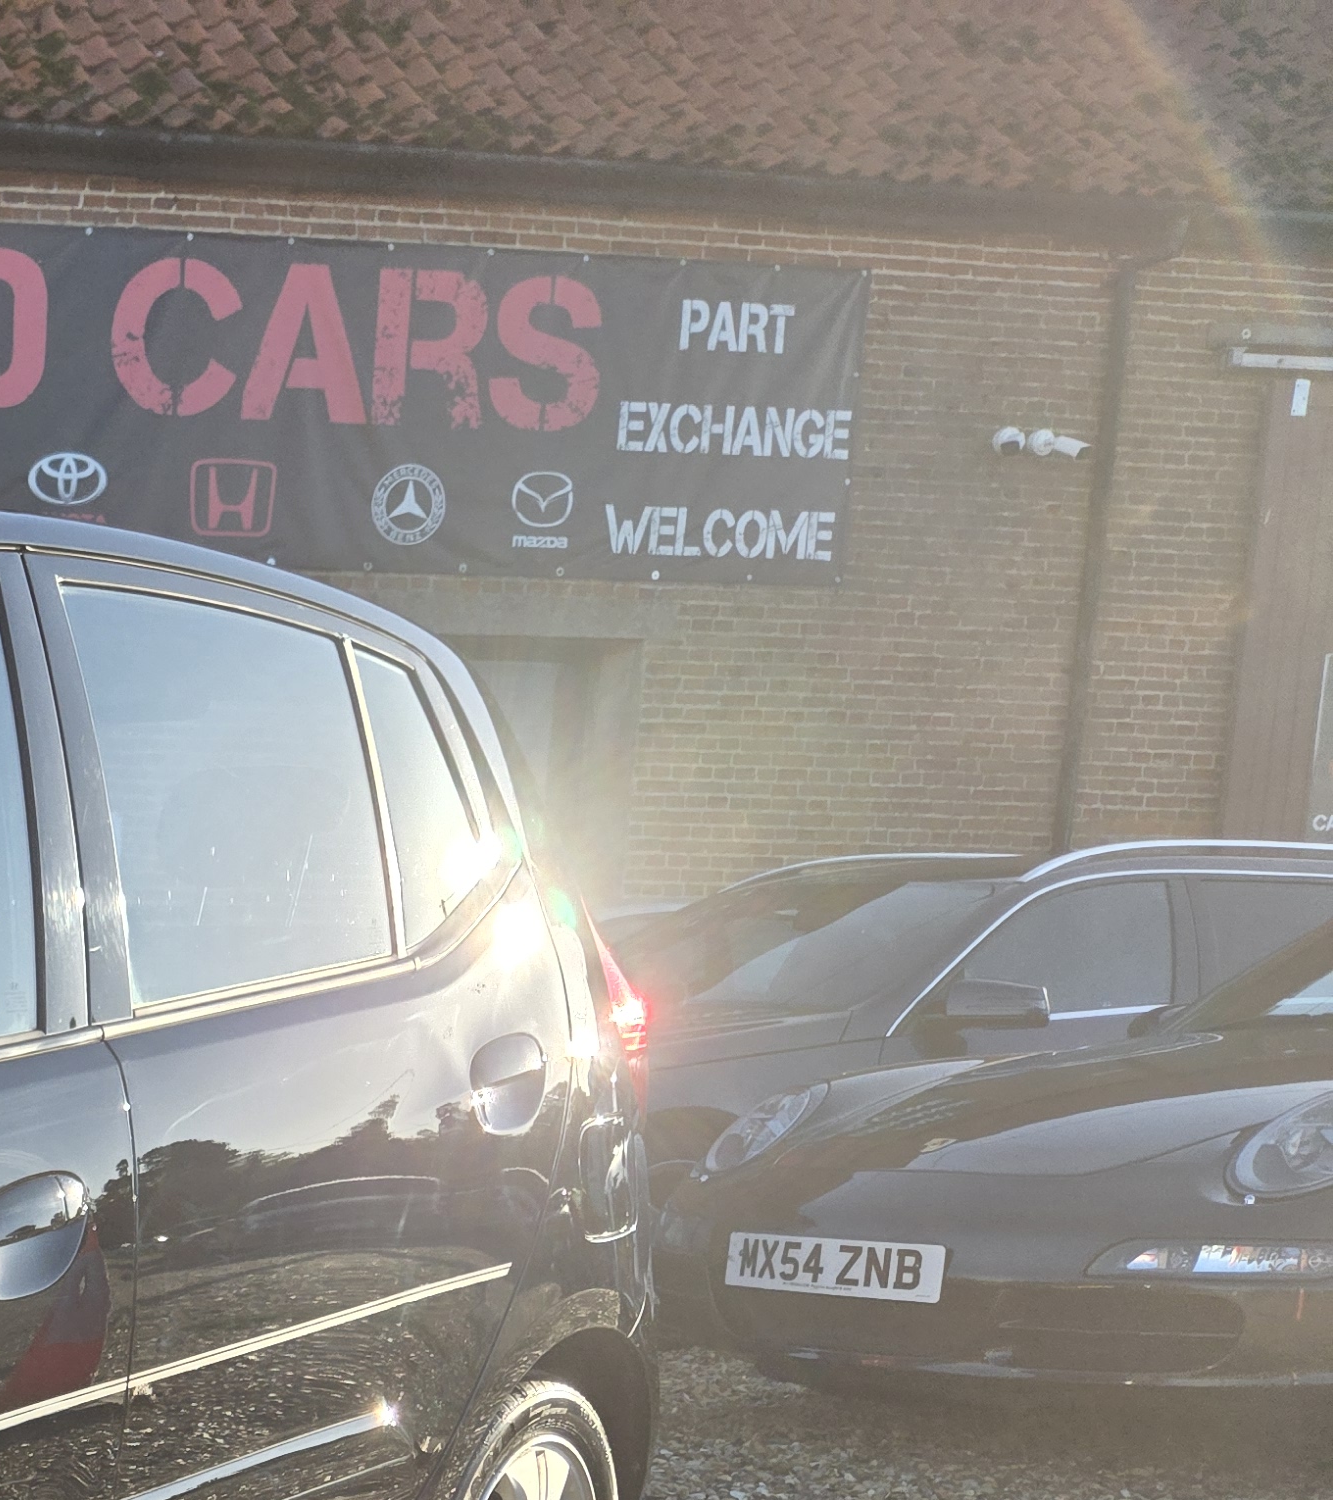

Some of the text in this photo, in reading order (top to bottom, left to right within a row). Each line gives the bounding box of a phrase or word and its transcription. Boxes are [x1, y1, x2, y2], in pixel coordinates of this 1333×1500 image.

[110, 256, 603, 432] CARS
[678, 298, 796, 354] PART
[616, 400, 853, 461] EXCHANGE
[605, 504, 836, 562] WELCOME
[739, 1238, 923, 1291] MX54 ZNB
